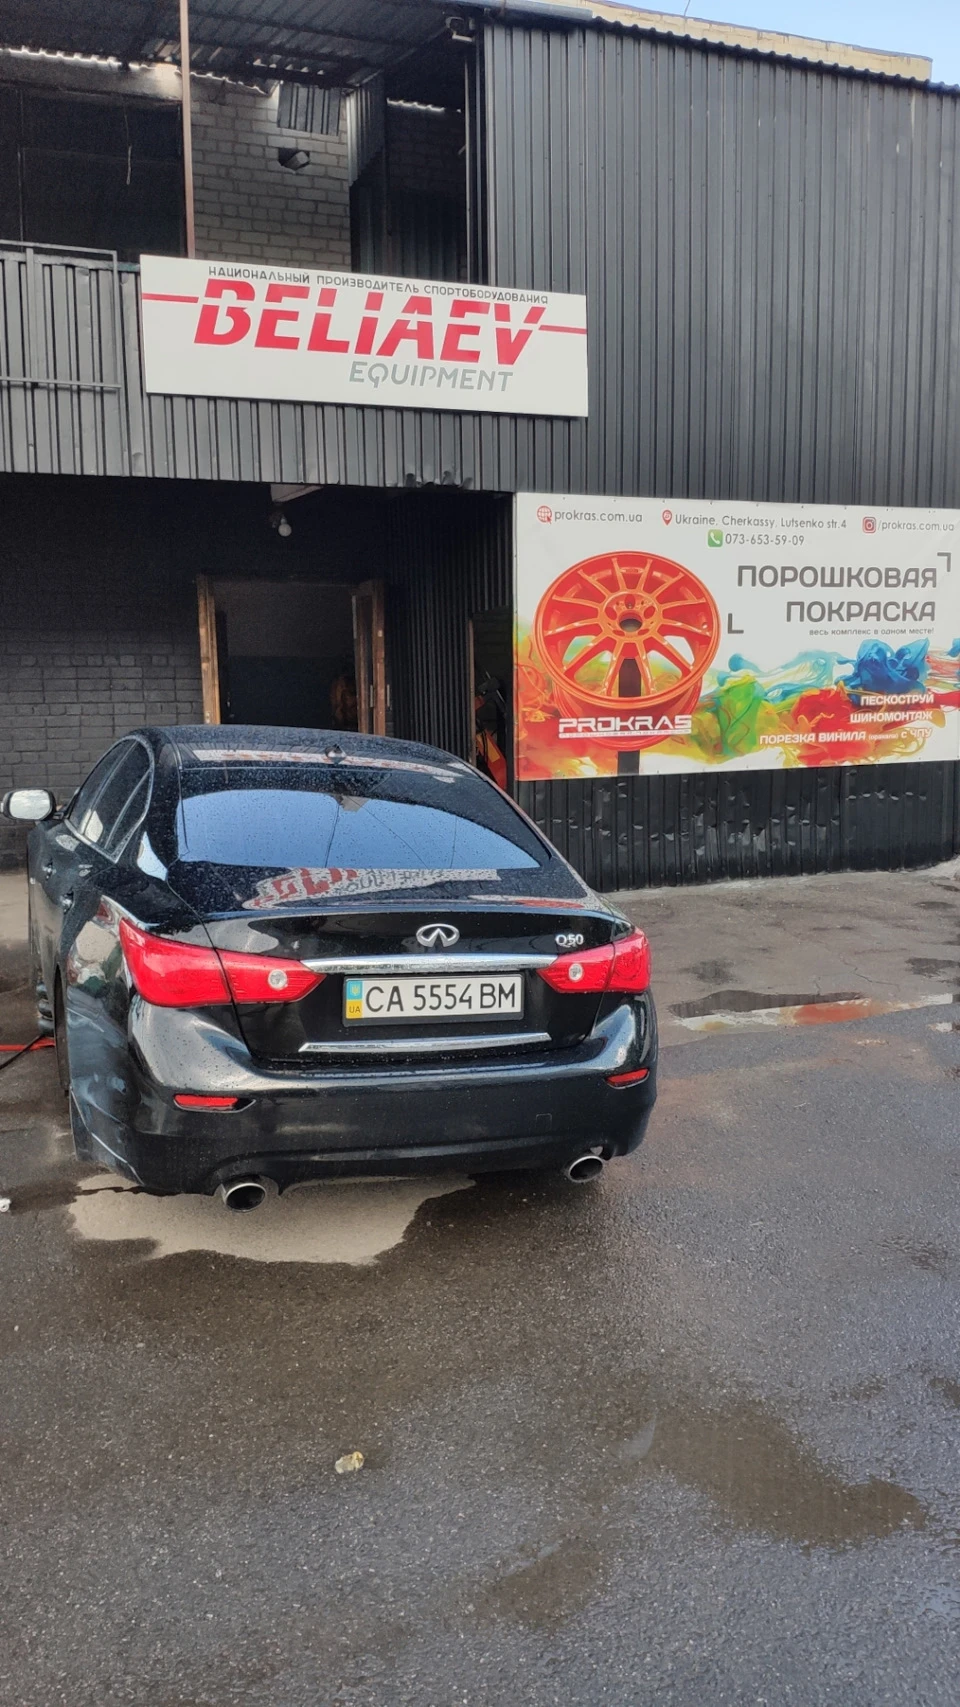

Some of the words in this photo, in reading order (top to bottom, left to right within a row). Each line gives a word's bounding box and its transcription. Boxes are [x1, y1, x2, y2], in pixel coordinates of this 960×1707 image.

[208, 266, 310, 284] НАЦИОНАЛЬНЫЙ
[316, 275, 419, 293] ПРОИЗВОДИТЕЛЬ
[424, 285, 548, 304] СПОРТОБОРУДОВАНИЯ
[194, 278, 546, 366] BELIAEV
[349, 361, 513, 392] EQUIPMENT
[554, 510, 643, 523] prokras.com.ua
[721, 515, 778, 528] Cherkassy,
[781, 517, 824, 529] Lutsenko
[827, 519, 847, 529] str.4
[725, 533, 805, 546] 073-653-59-09
[737, 565, 937, 588] ПОРОШКОВАЯ
[786, 601, 936, 622] ПОКРАСКА
[831, 628, 871, 636] комплекс
[881, 627, 906, 635] одном
[909, 627, 934, 635] месте!
[860, 693, 934, 706] ПЕСКОСТРУЙ
[558, 715, 692, 733] PROKRAS
[850, 710, 932, 724] ШИНОМОНТАЖ
[759, 732, 815, 745] ПОРЕЗКА
[818, 730, 866, 743] ВИНИЛА
[911, 728, 932, 739] ЧПУ
[555, 933, 584, 948] Q50
[365, 985, 404, 1012] CA
[413, 984, 472, 1011] 5554
[480, 982, 516, 1009] BM
[348, 1005, 361, 1014] UA
